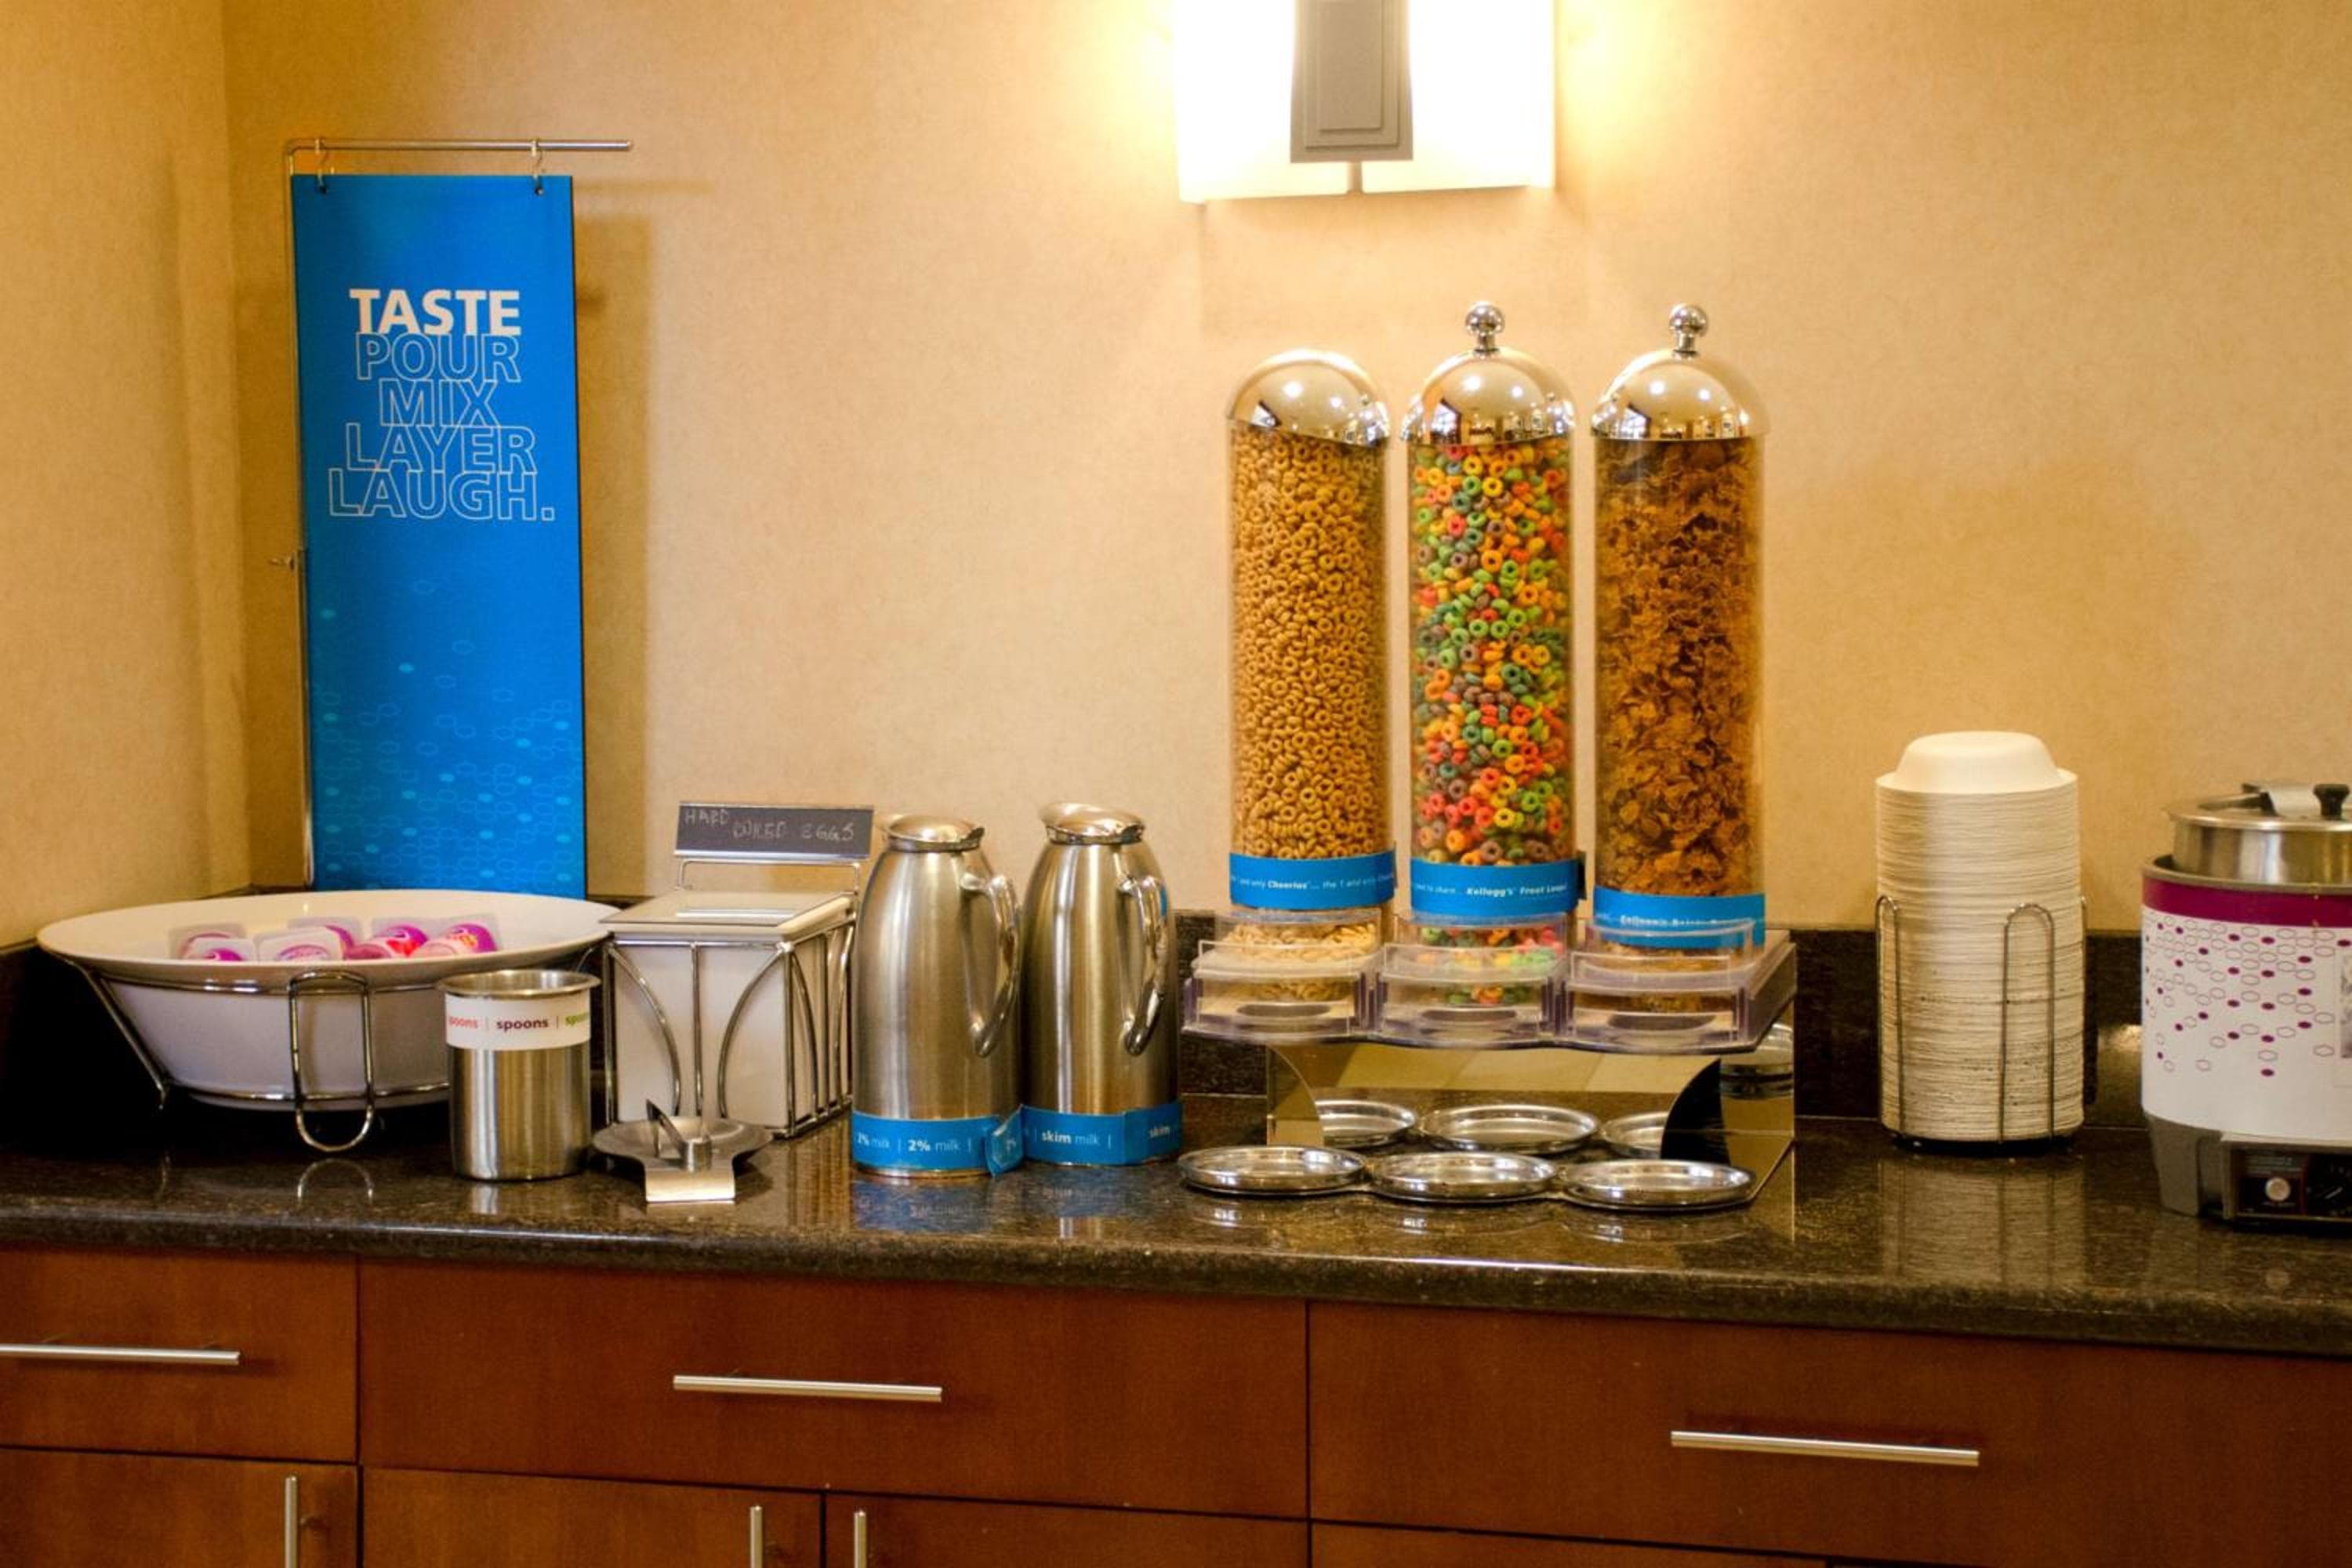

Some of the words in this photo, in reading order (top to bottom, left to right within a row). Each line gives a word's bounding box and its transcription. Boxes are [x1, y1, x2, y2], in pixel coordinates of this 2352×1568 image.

[350, 289, 521, 336] TASTE
[356, 332, 521, 383] POUR
[379, 378, 499, 428] MIX
[346, 423, 538, 475] LAYER
[328, 468, 555, 521] LAUGH.
[801, 822, 854, 841] EGGS
[496, 1018, 549, 1033] spoons
[908, 1139, 931, 1152] 2%
[935, 1138, 960, 1151] milk
[1041, 1129, 1072, 1145] skim
[1075, 1133, 1101, 1146] milk
